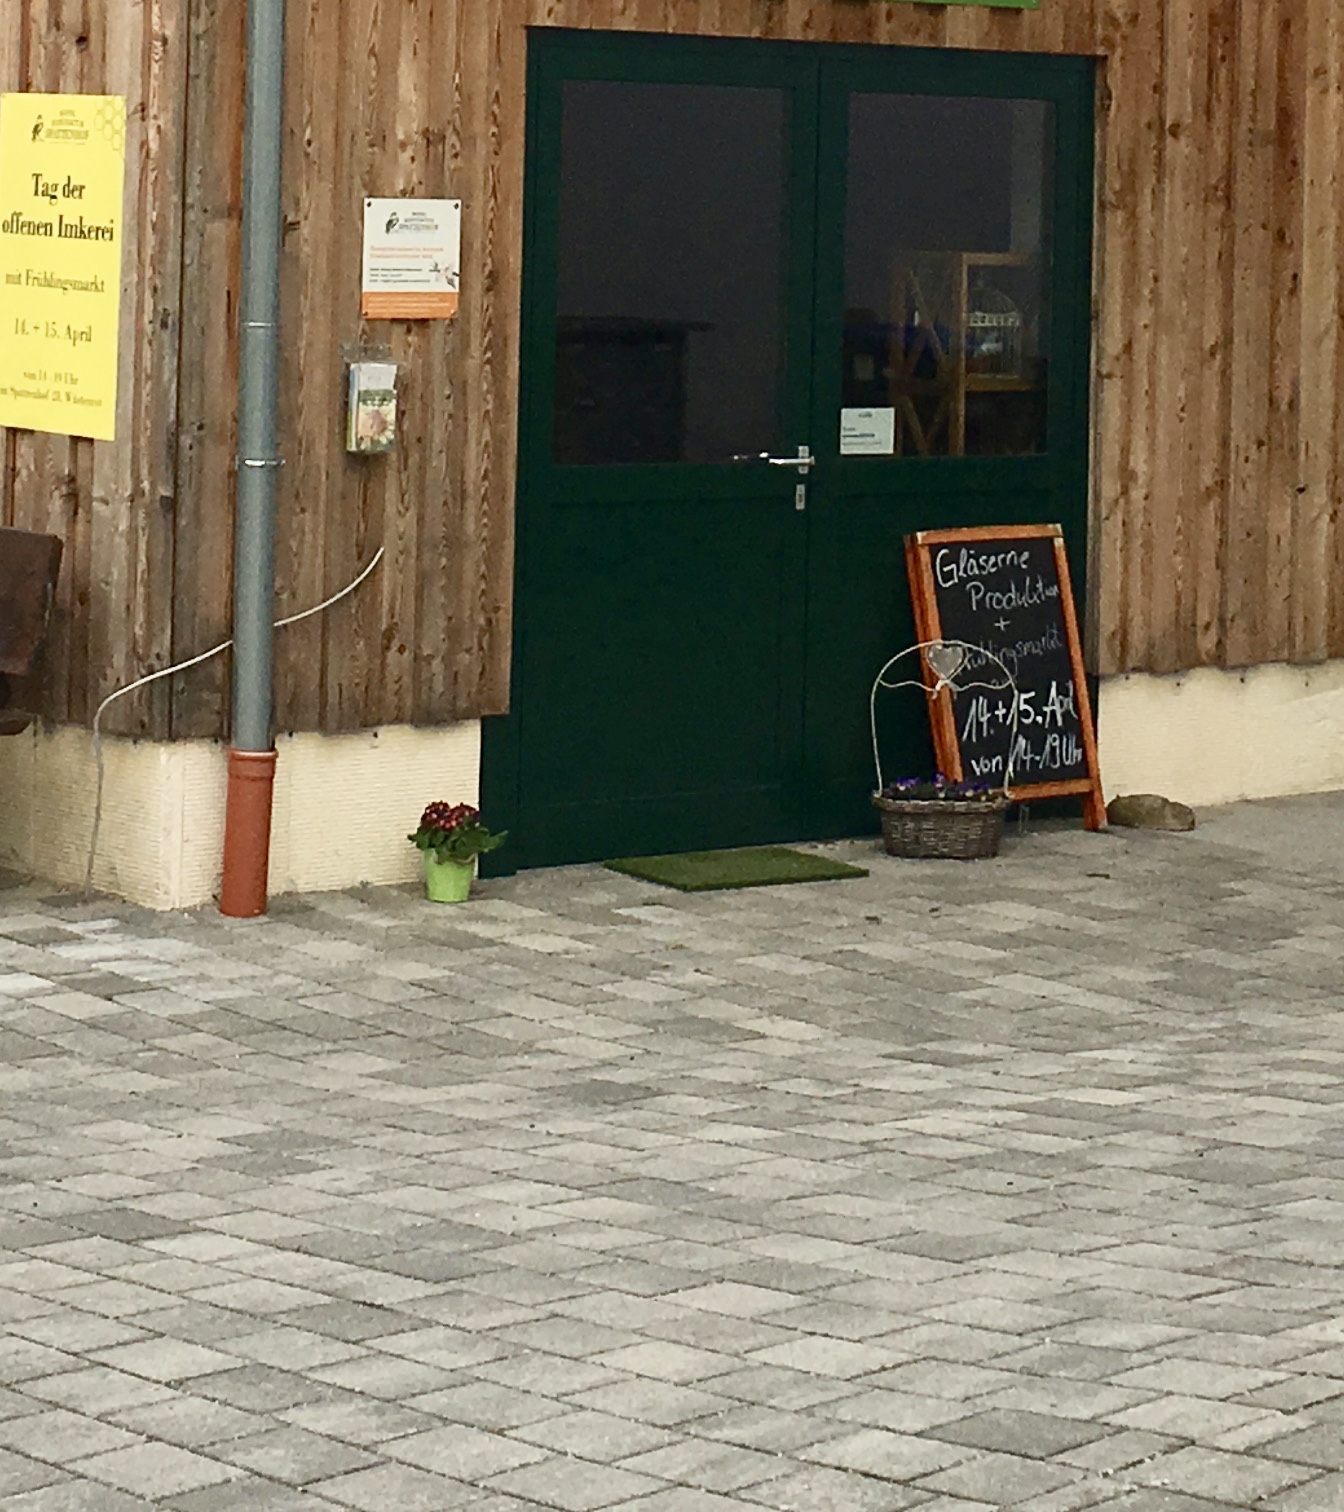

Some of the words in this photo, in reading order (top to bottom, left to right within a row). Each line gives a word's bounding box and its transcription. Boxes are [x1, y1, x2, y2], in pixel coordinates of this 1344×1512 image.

[31, 173, 59, 206] Tag
[62, 175, 86, 200] der
[2, 211, 53, 237] offenen
[57, 214, 114, 241] Imkerei
[5, 270, 22, 285] mit
[25, 269, 105, 295] Frühlingsmarkt
[64, 324, 92, 347] April
[936, 547, 1030, 588] Gläserne
[966, 574, 1060, 611] Produktion
[993, 616, 1011, 632] +
[971, 754, 1003, 776] von
[1063, 733, 1083, 766] Uhr
